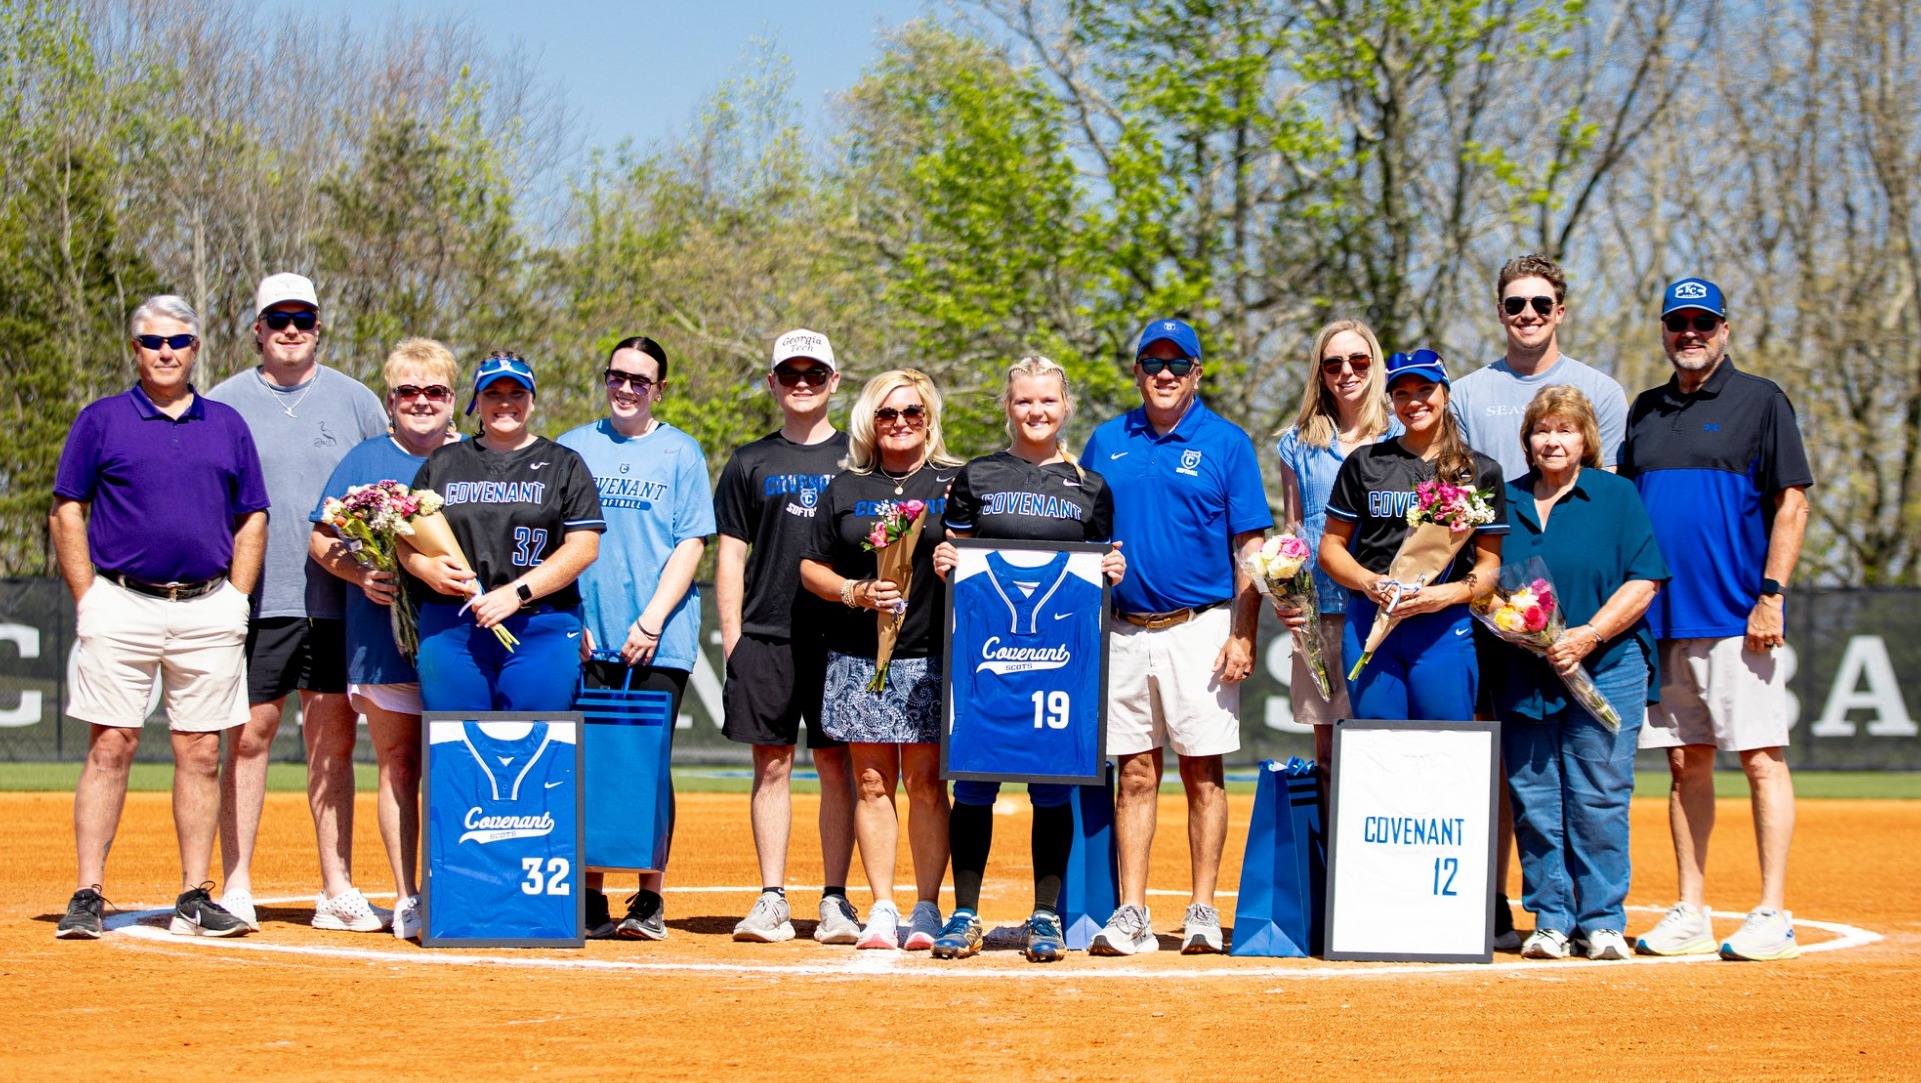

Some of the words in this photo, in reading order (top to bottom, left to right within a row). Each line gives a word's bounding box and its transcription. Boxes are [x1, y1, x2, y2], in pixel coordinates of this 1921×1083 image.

[782, 335, 822, 347] Georgia
[791, 344, 814, 352] Tech
[445, 481, 545, 506] COVENANT
[593, 477, 668, 501] VENANT
[600, 499, 641, 509] OFTBALL
[982, 491, 1082, 520] COVENANT
[512, 526, 548, 566] 32
[982, 635, 1071, 662] Covenant
[1006, 663, 1033, 671] SCOTS
[1031, 690, 1070, 730] 19
[464, 806, 555, 831] Covenant
[1364, 816, 1464, 846] COVENANT
[490, 831, 517, 840] SCOTS
[521, 857, 570, 896] 32
[1433, 857, 1458, 896] 12
